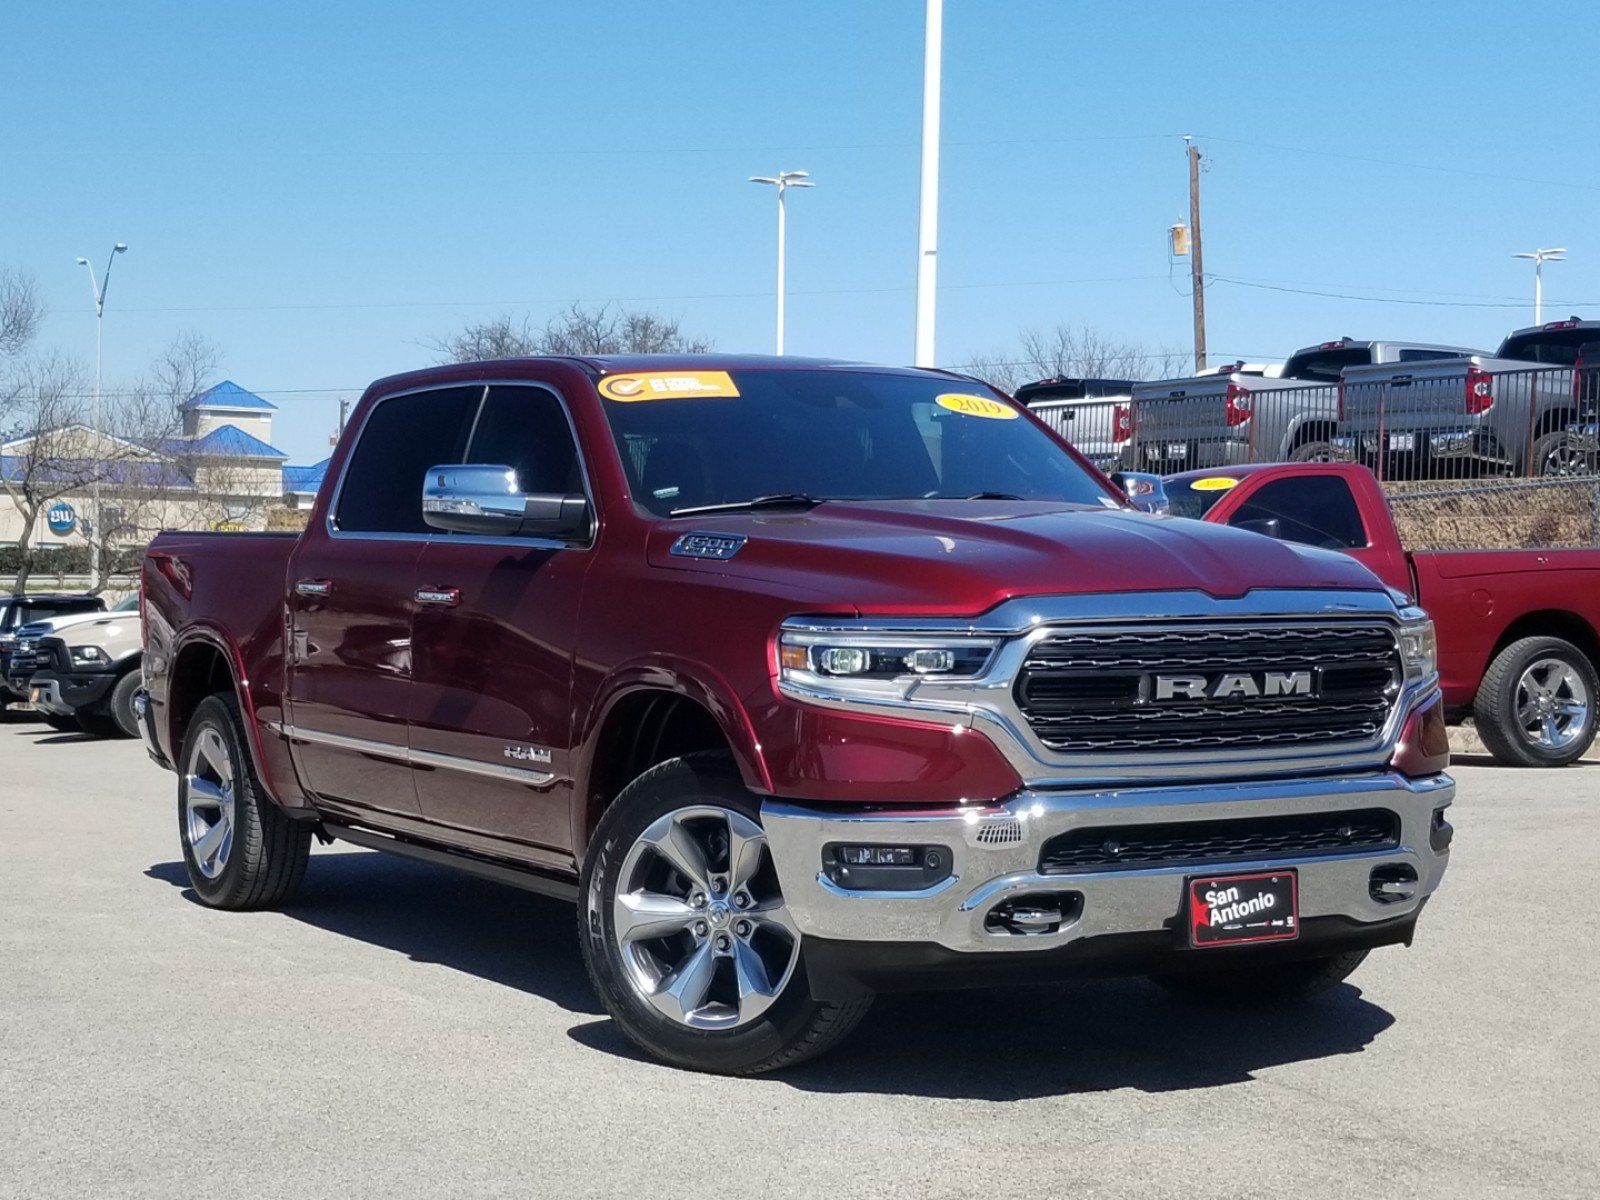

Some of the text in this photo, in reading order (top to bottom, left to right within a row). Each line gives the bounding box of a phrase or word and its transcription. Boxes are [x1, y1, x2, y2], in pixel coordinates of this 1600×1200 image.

[952, 398, 1002, 414] 2019
[1156, 671, 1312, 700] RAM
[1204, 886, 1239, 909] San
[1209, 891, 1275, 928] Antonio
